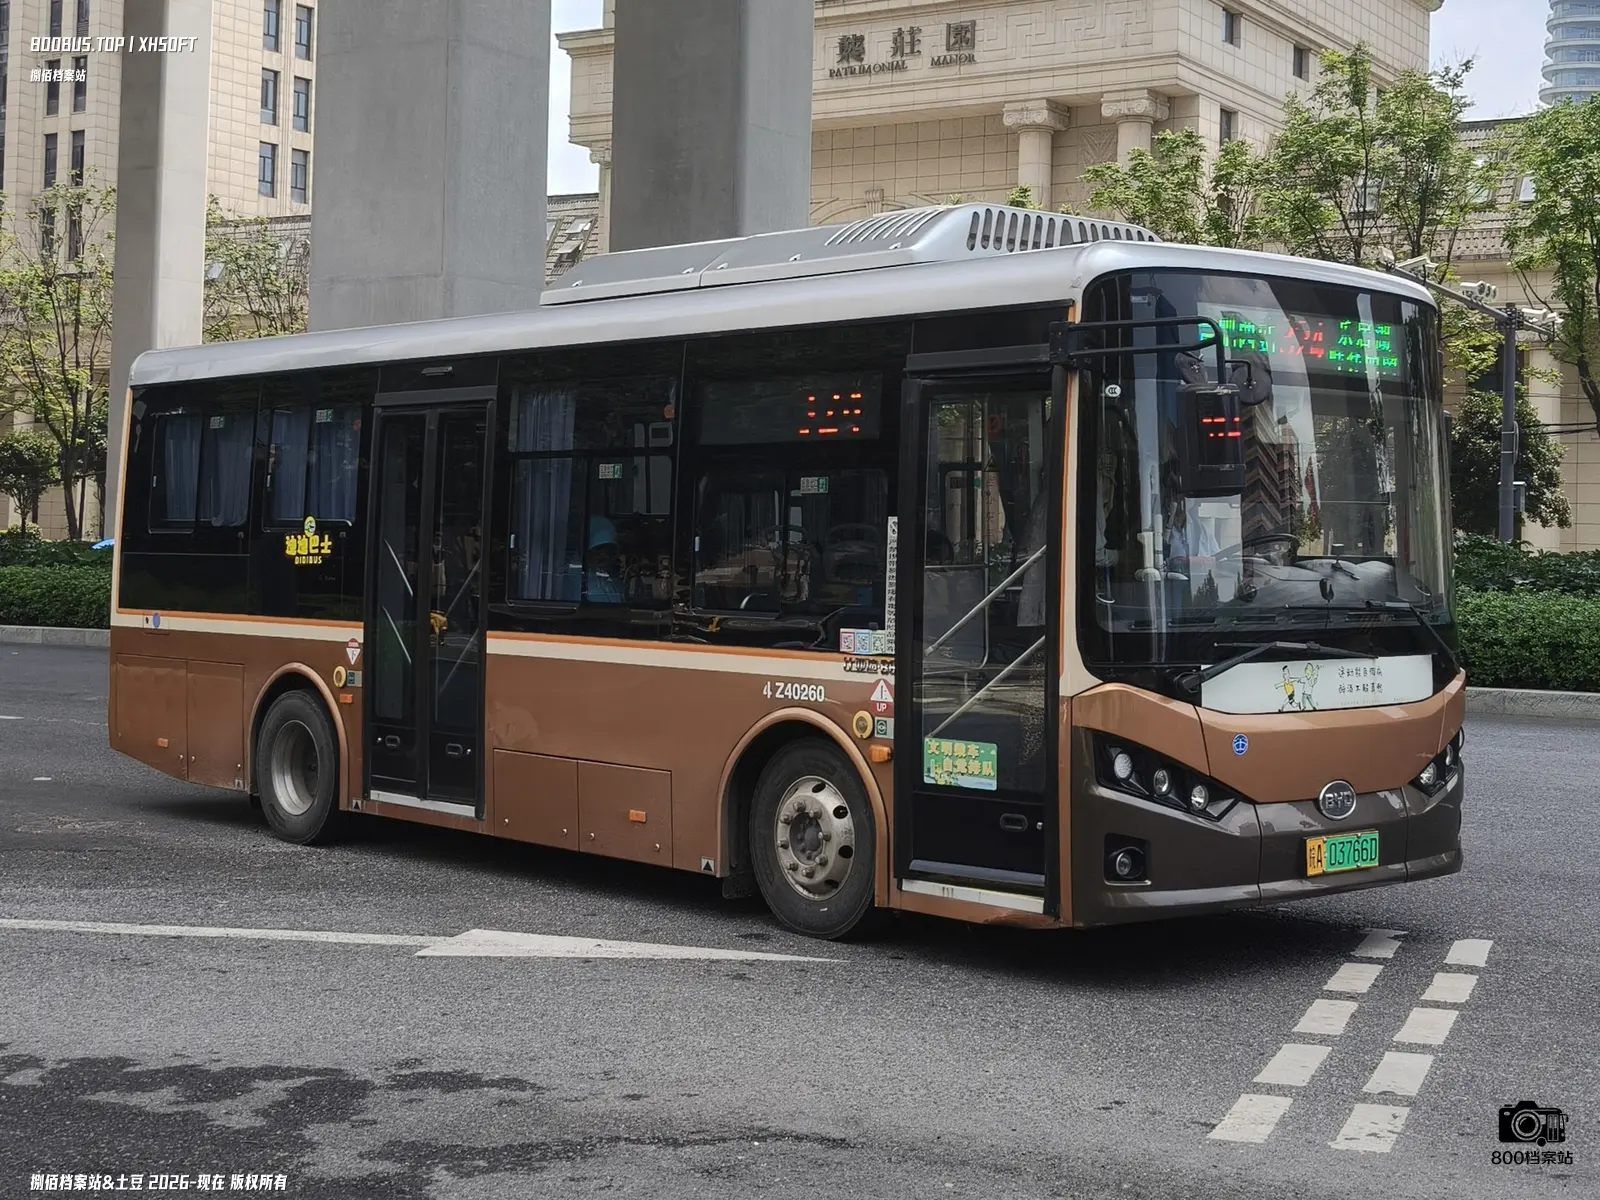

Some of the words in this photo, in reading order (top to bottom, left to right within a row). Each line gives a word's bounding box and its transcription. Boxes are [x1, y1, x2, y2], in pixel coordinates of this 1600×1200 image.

[829, 59, 908, 78] PATRIMONIAL
[930, 53, 977, 67] MANOR
[775, 682, 825, 702] Z40260
[876, 702, 887, 712] UP
[1325, 790, 1353, 809] BYD
